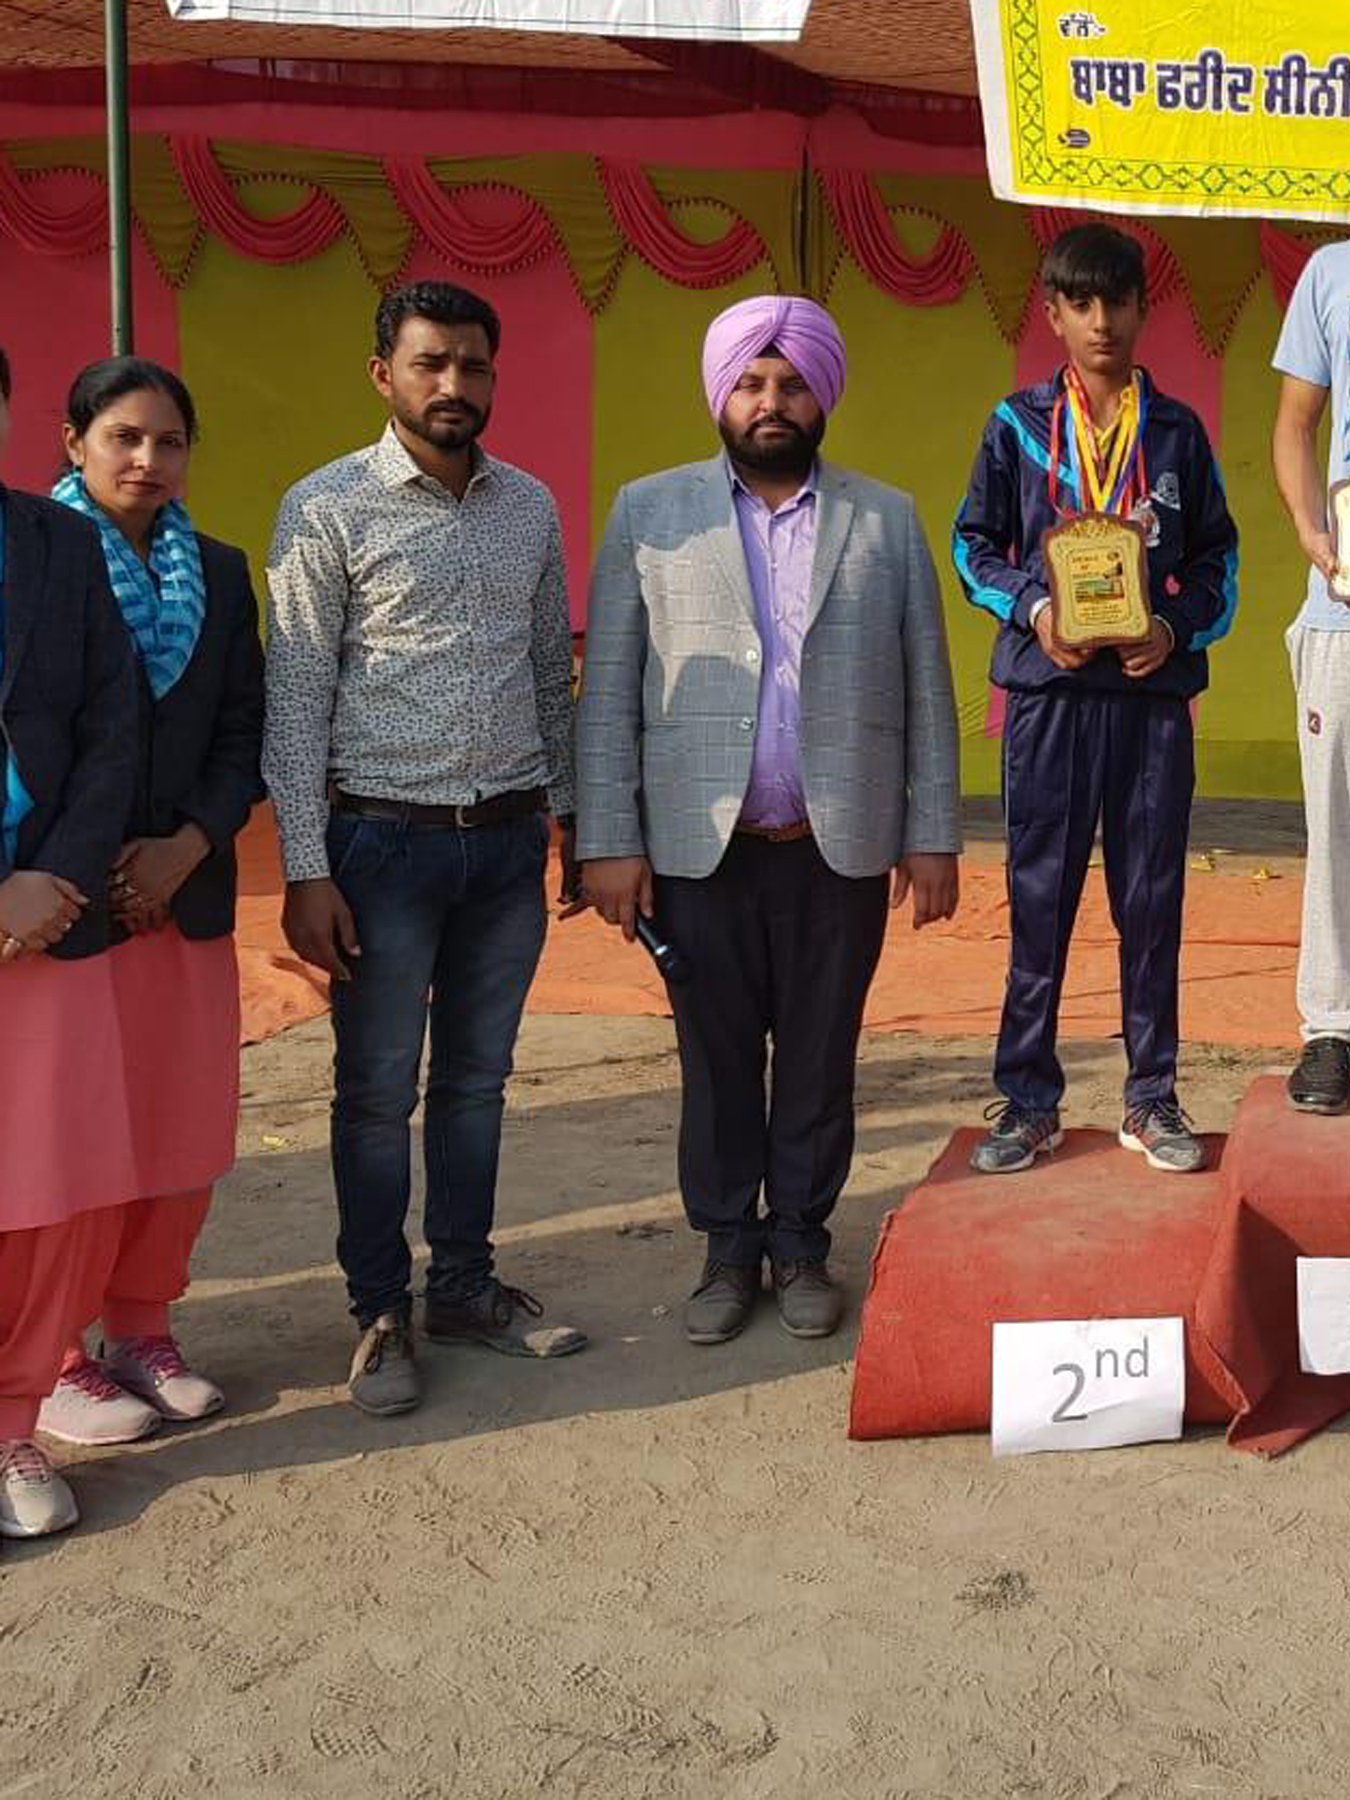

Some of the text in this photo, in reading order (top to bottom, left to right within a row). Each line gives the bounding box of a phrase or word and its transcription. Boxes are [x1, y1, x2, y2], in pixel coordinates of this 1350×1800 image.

[1070, 59, 1146, 106] ਬਾਬਾ
[1156, 49, 1253, 112] ਫਰੀਦ
[1049, 1337, 1150, 1424] 2nd
